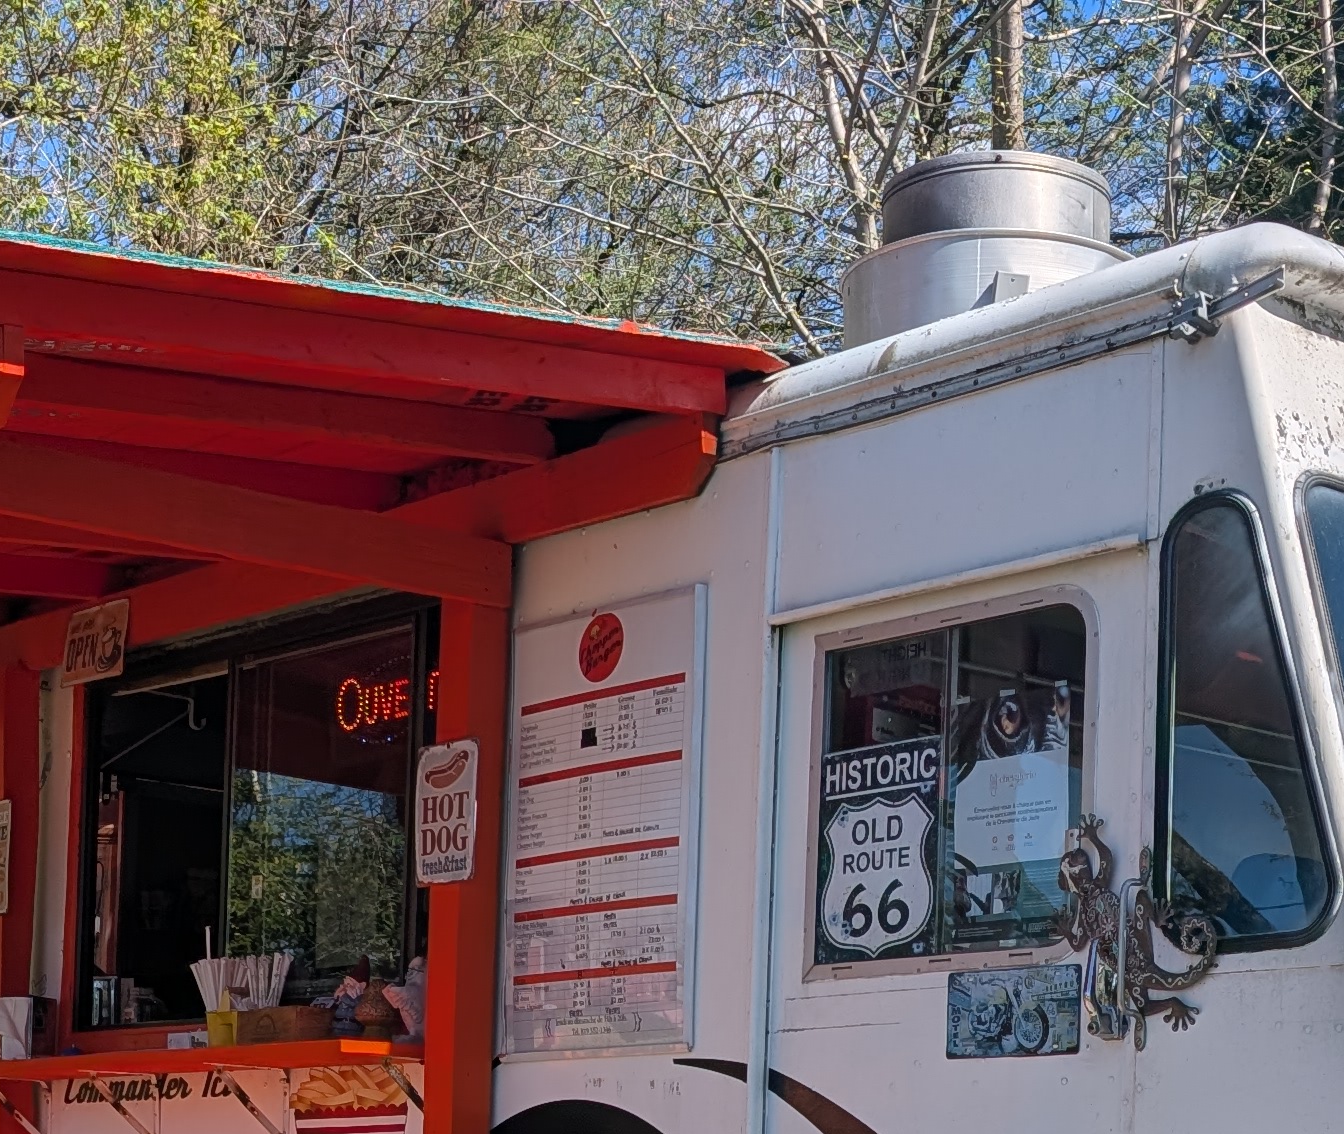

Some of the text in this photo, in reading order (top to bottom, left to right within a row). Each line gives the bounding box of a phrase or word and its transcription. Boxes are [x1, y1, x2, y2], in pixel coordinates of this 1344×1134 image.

[65, 632, 99, 673] OPEN
[825, 748, 937, 794] HISTORIC
[421, 791, 470, 825] HOT
[421, 822, 468, 856] DOG
[851, 814, 903, 846] OLD
[422, 855, 467, 877] fresh&fast
[842, 846, 911, 875] ROUTE
[842, 878, 910, 938] 66
